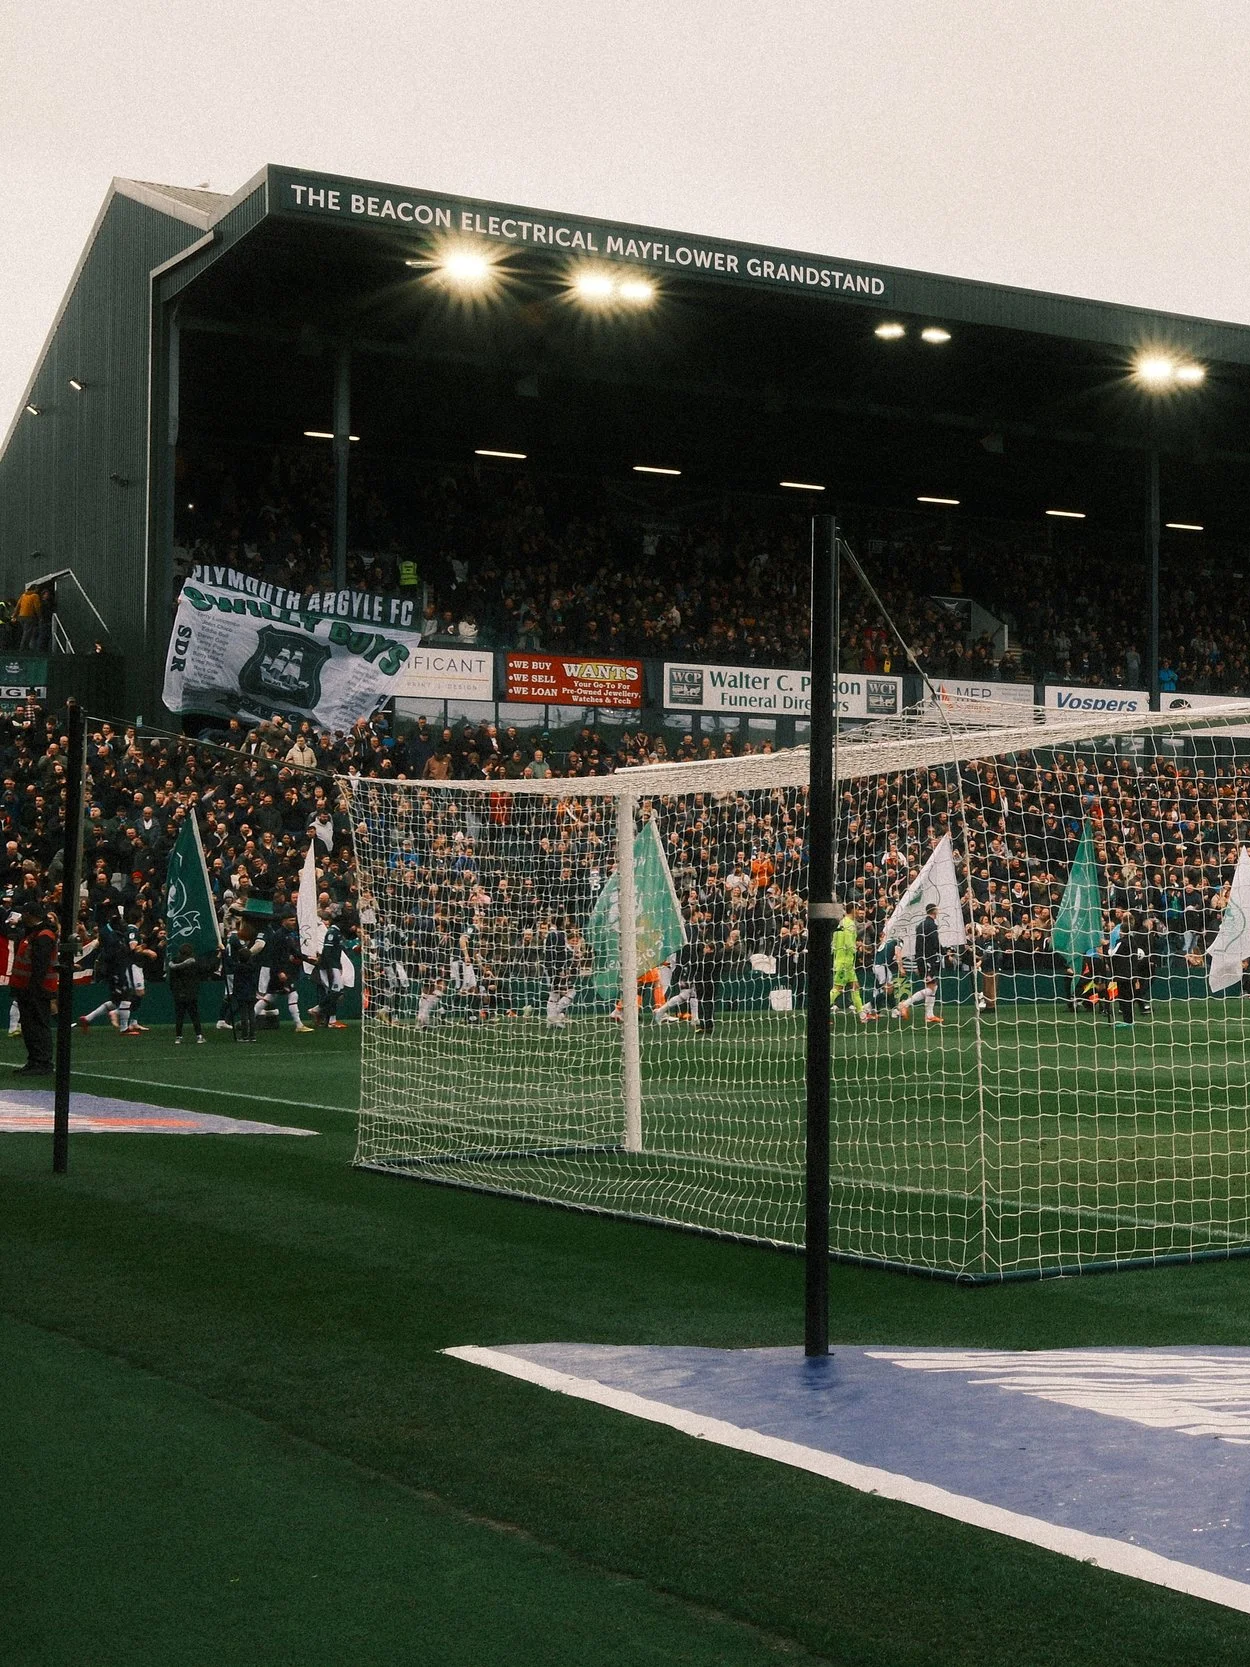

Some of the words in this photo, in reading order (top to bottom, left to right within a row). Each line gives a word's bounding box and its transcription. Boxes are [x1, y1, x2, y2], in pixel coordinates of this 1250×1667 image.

[291, 184, 341, 211] THE
[351, 194, 452, 228] BEACON
[461, 212, 598, 253] ELECTRICAL
[606, 236, 739, 274] MAYFLOWER
[747, 258, 885, 296] GRANDSTAND
[192, 565, 301, 610] PLYMOUTH
[308, 590, 383, 622] ARGYLE
[390, 599, 414, 626] FC
[170, 625, 192, 672] SDR
[513, 661, 529, 669] WE
[532, 661, 552, 670] BUY
[562, 663, 639, 681] WANTS
[671, 671, 703, 683] WCP
[513, 674, 529, 682] WE
[531, 674, 556, 684] SELL
[709, 671, 770, 690] Walter
[776, 675, 794, 692] C.
[513, 686, 529, 695] WE
[531, 688, 558, 697] LOAN
[593, 681, 616, 689] Go-To
[617, 682, 631, 690] For
[869, 682, 896, 694] WCP
[562, 687, 602, 696] Pre-Owned
[603, 689, 641, 699] Jewellery,
[572, 695, 604, 704] Watches
[605, 696, 612, 704] &
[613, 697, 631, 705] Tech
[721, 693, 777, 709] Funeral
[1057, 692, 1138, 712] Vospers
